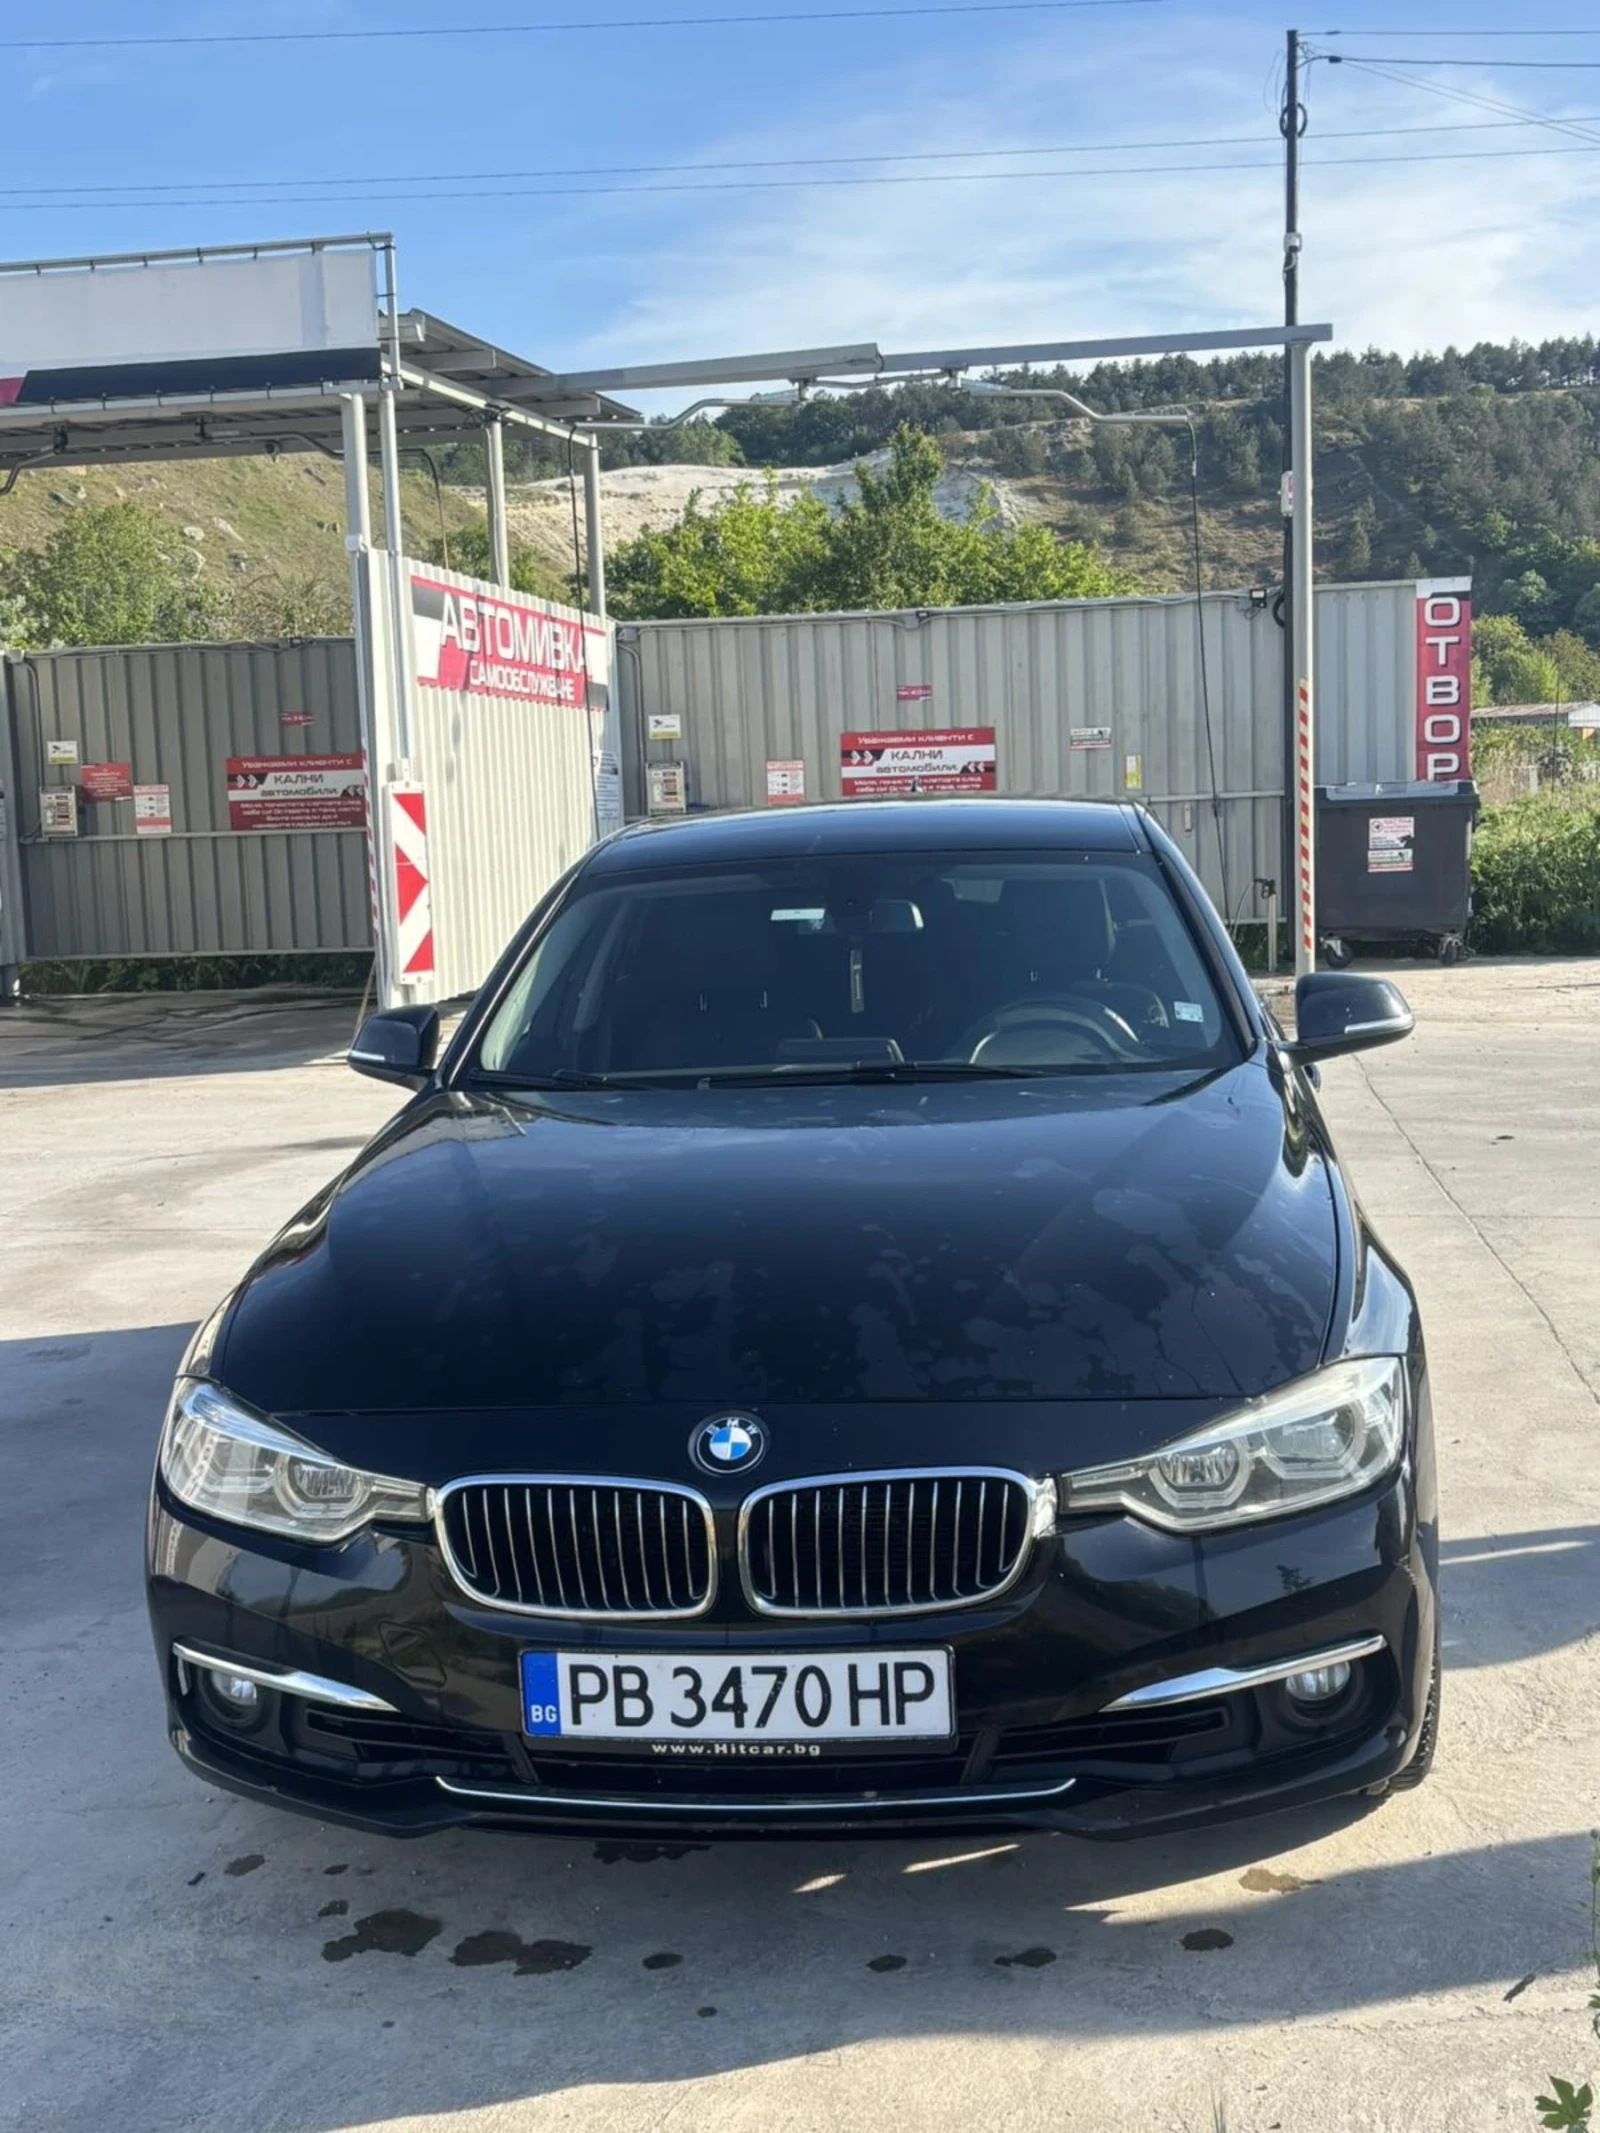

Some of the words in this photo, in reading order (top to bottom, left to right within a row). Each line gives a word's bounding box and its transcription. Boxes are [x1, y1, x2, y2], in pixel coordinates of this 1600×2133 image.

[441, 592, 591, 676] АВТОМИВКА
[891, 750, 943, 761] КАЛНИ
[273, 774, 324, 785] КАЛНИ
[705, 1418, 760, 1435] BMW
[569, 1664, 654, 1727] PB
[670, 1665, 832, 1728] 3470
[848, 1661, 935, 1727] HP
[530, 1704, 557, 1723] BG
[651, 1743, 821, 1756] www.Hitcar.bg
